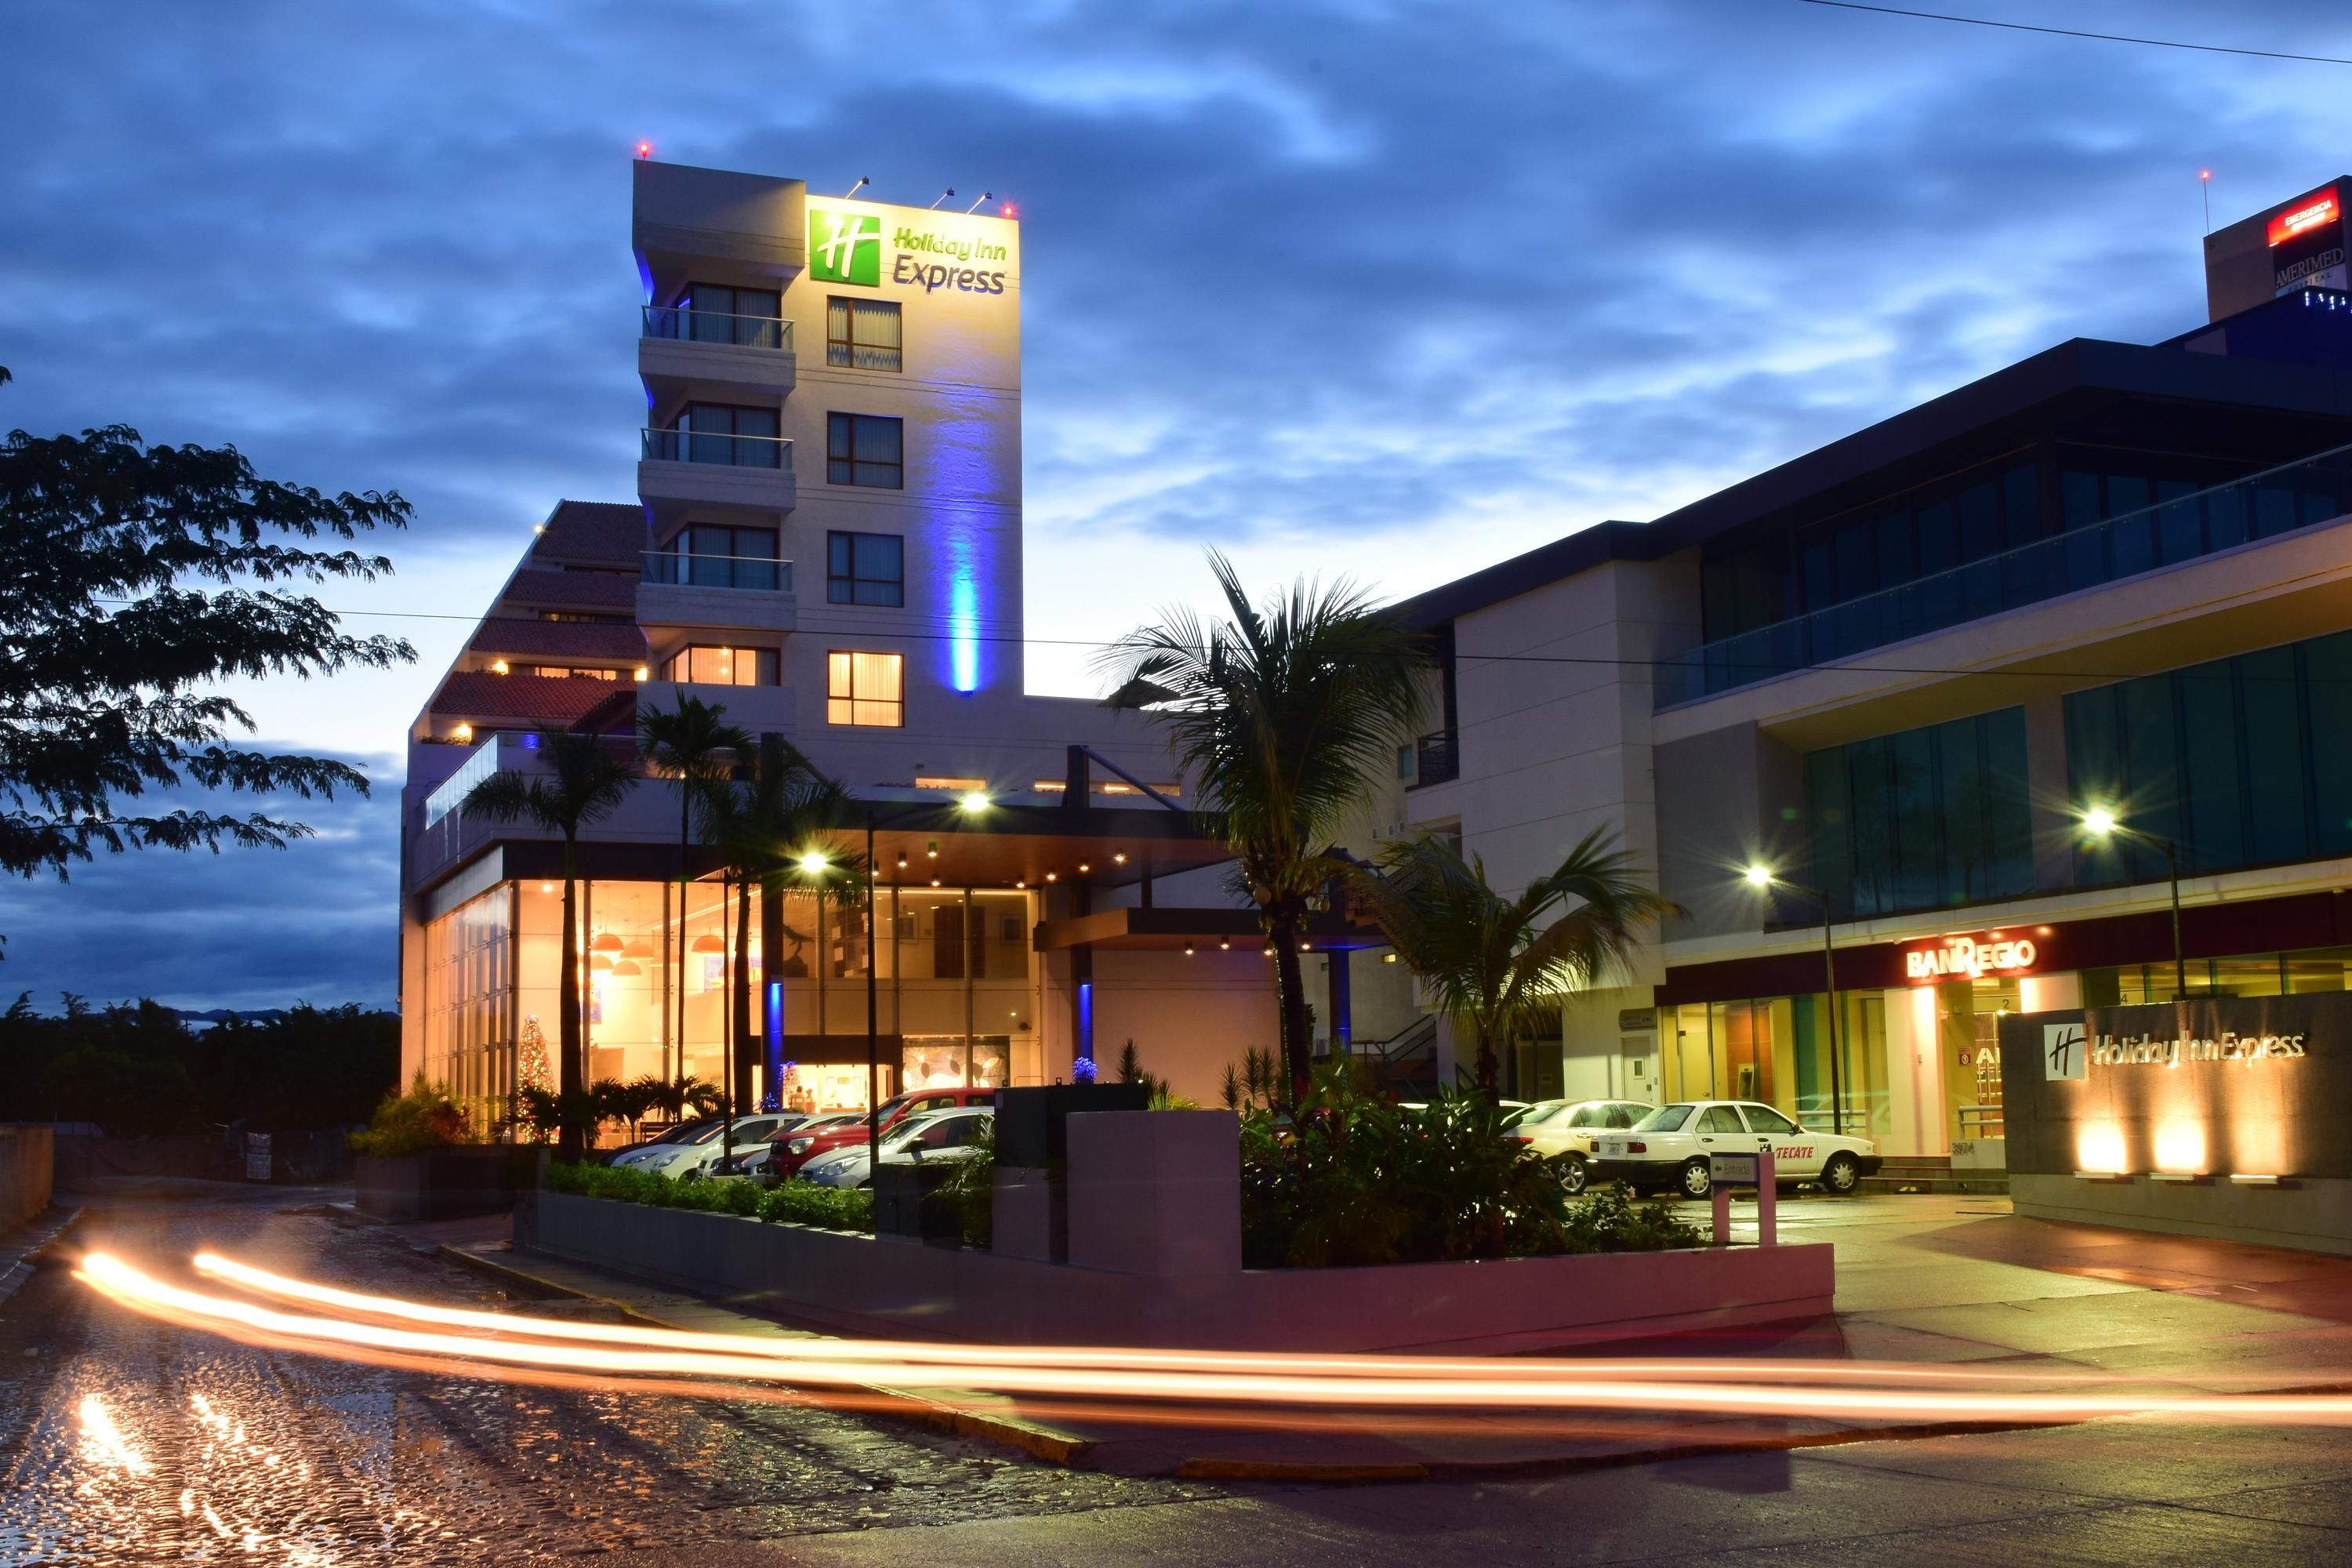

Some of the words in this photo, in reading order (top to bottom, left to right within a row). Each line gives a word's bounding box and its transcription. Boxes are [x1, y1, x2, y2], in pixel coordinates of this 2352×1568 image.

[894, 227, 971, 261] Holiday
[975, 238, 1007, 261] Inn
[892, 254, 1006, 295] Express
[2276, 248, 2344, 289] AMERIMED
[2002, 999, 2009, 1009] 2
[2120, 993, 2128, 1004] 4
[2092, 1033, 2180, 1068] Holiday
[2180, 1029, 2218, 1061] Inn
[2220, 1031, 2305, 1066] Express
[1776, 1146, 1814, 1159] TECATE
[1724, 1162, 1751, 1174] Entrada
